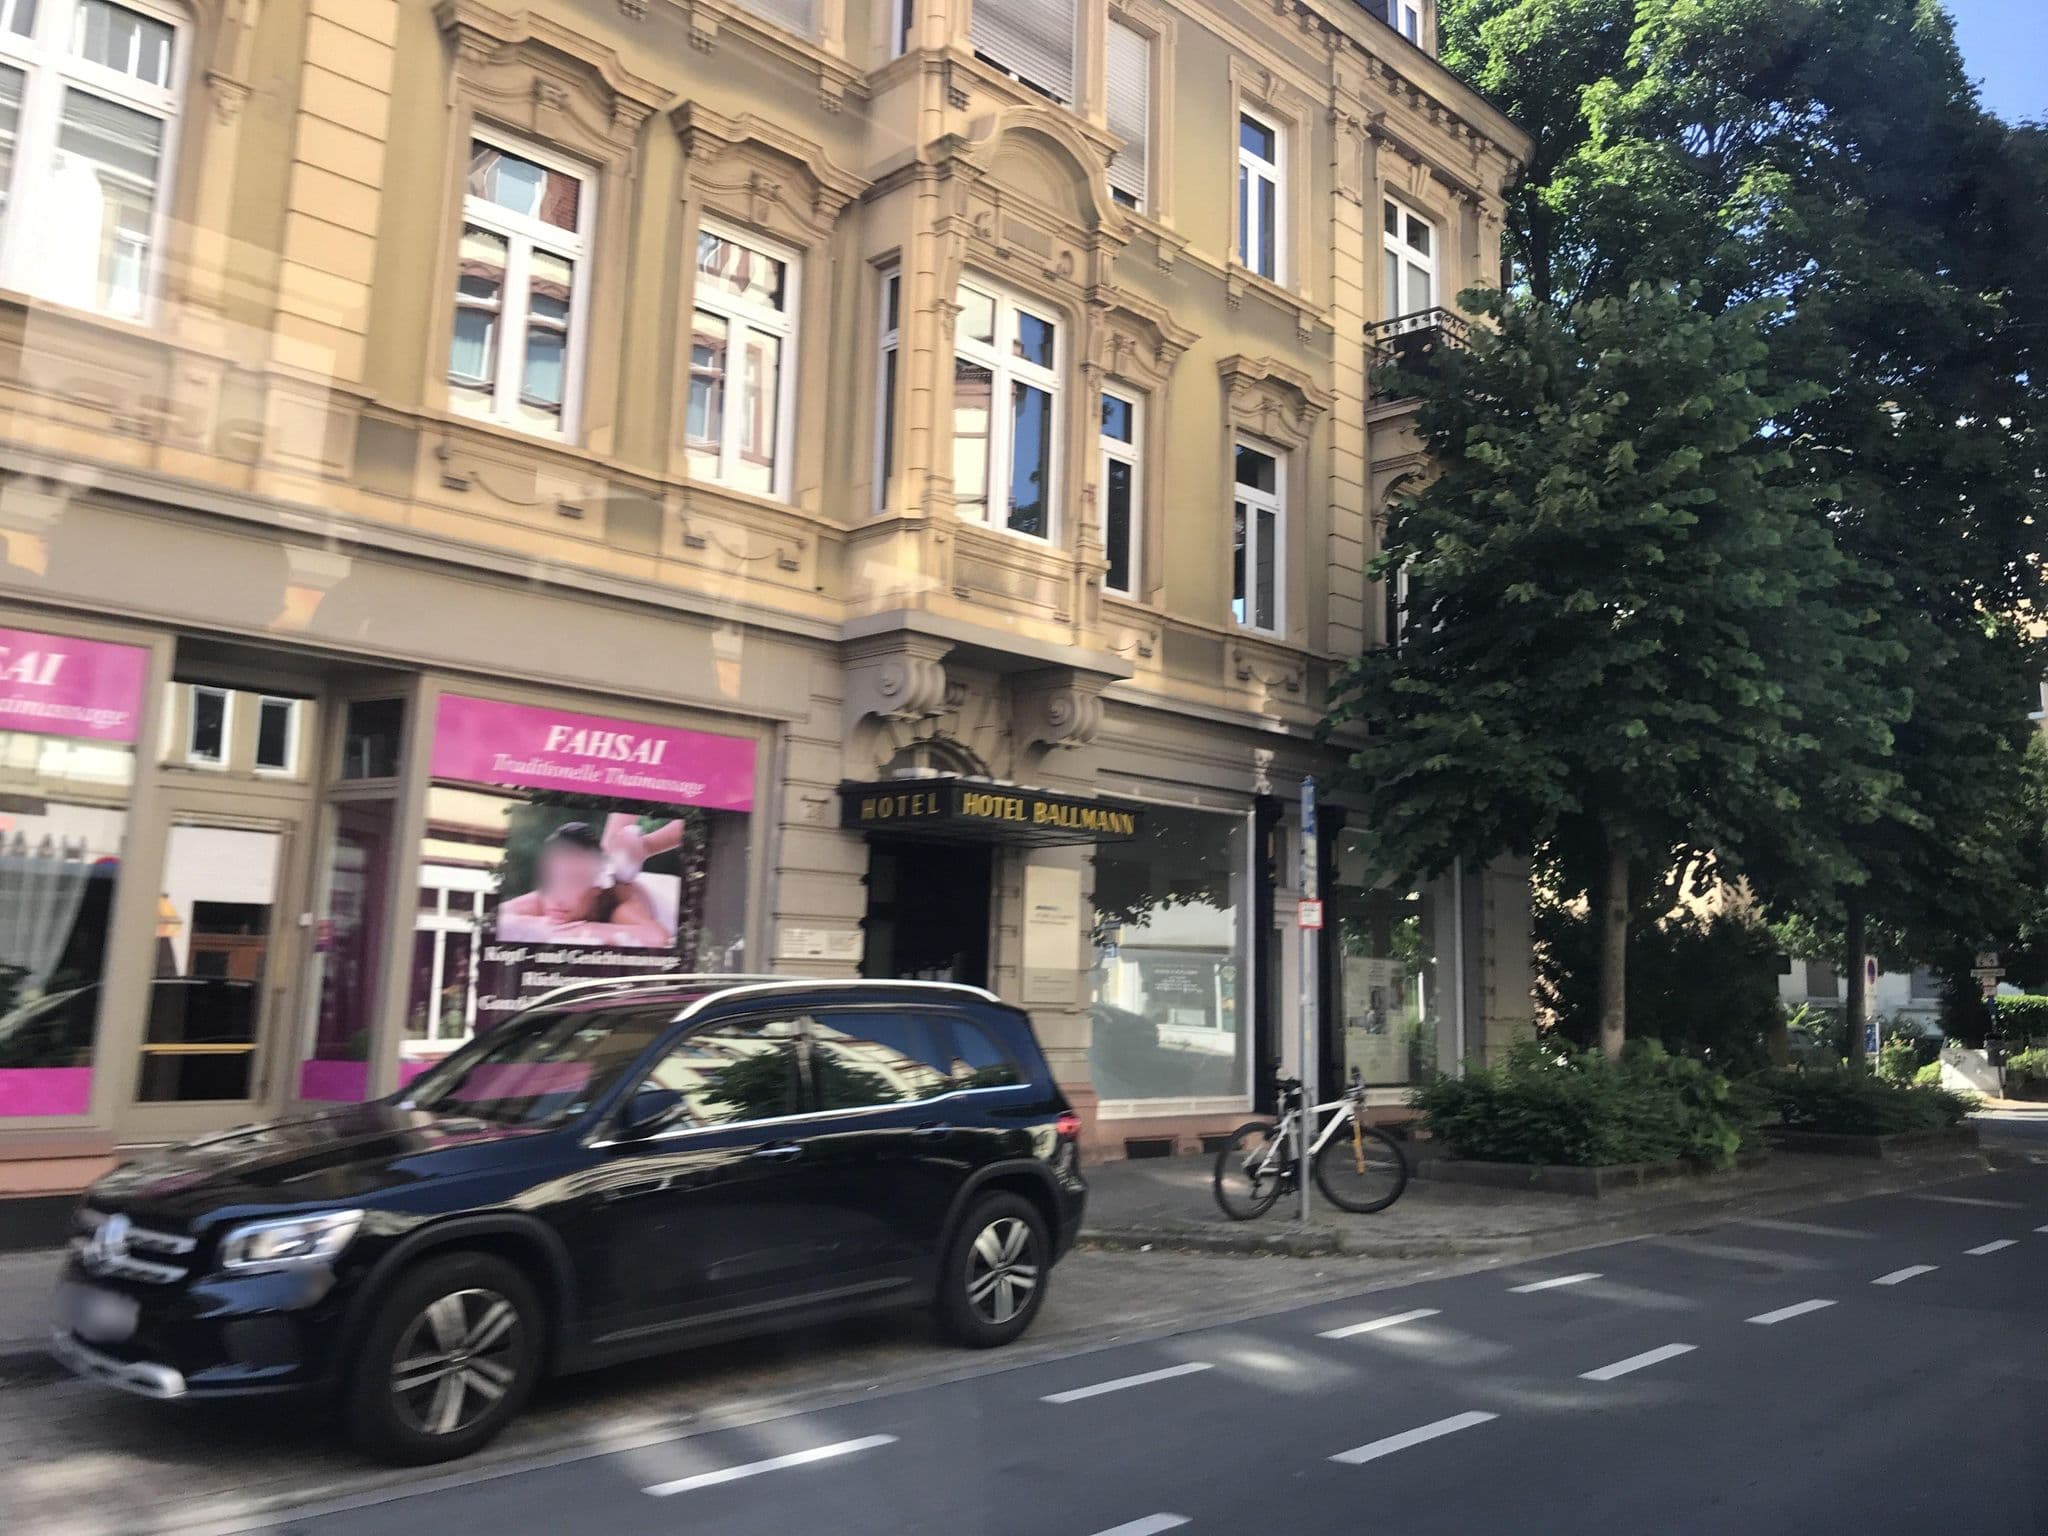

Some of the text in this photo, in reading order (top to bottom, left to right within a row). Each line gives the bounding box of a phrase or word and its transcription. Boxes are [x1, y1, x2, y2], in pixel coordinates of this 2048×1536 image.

[543, 724, 668, 766] FAHSAI
[492, 753, 707, 799] Traditionelle Thaimassage
[862, 792, 940, 820] HOTEL
[962, 792, 1136, 836] HOTEL BALLMANN
